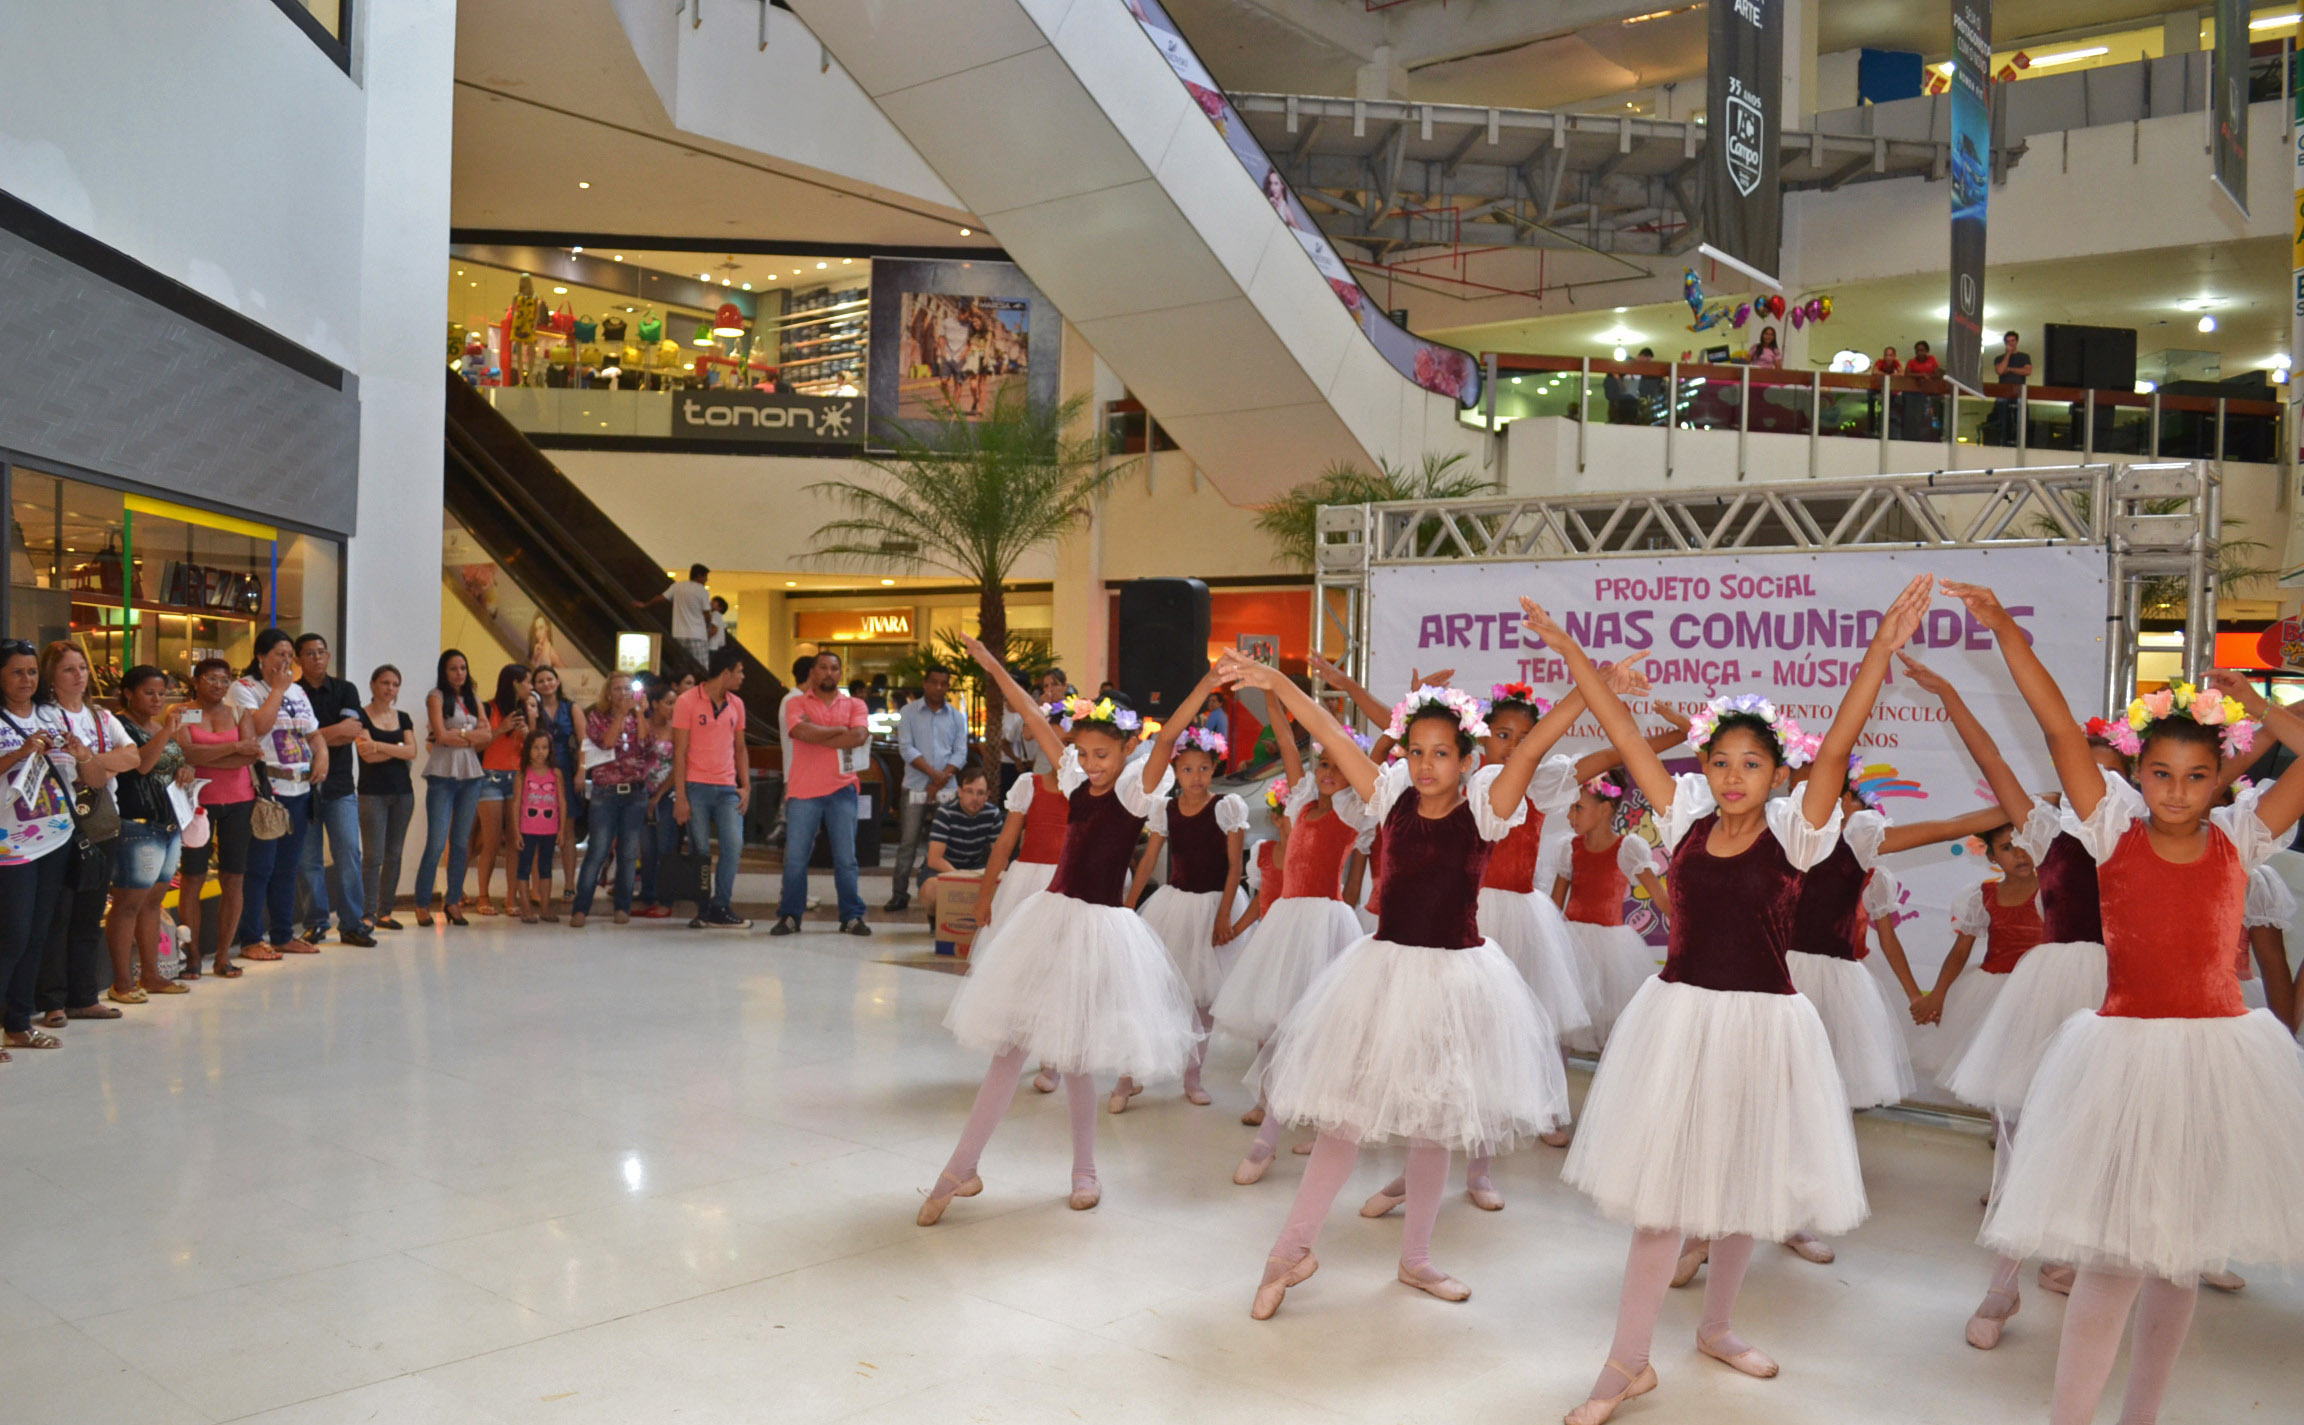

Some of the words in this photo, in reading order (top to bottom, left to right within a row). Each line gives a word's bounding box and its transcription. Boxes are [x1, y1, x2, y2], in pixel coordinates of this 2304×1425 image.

[1734, 0, 1763, 29] ARTE.
[1729, 76, 1741, 96] 35
[1730, 136, 1759, 165] Campo
[684, 399, 814, 428] tonon
[1595, 576, 1710, 601] PROJETO
[861, 616, 909, 633] VIVARA
[1565, 610, 1654, 650] NAS
[1645, 657, 1740, 698] DANÇA
[699, 714, 707, 727] 3
